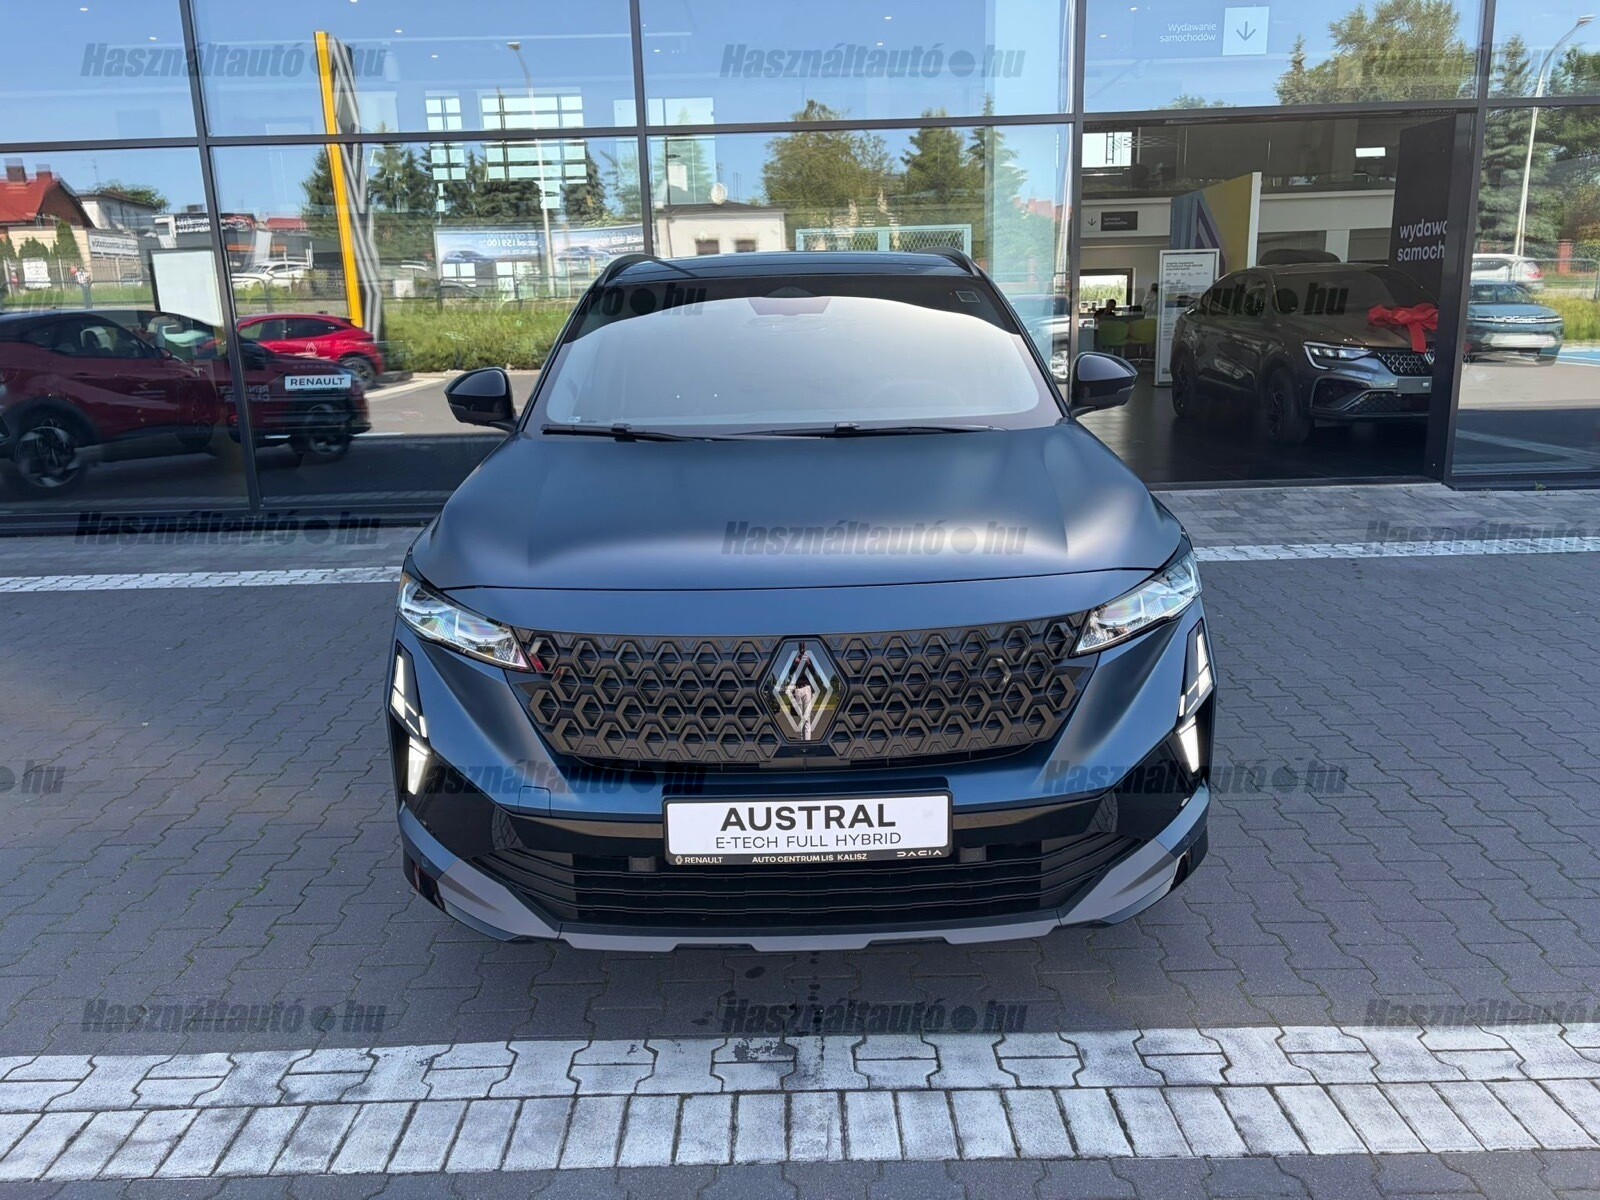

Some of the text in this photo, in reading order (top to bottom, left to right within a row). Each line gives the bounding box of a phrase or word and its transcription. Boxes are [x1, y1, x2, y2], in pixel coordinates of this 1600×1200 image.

[1167, 21, 1217, 33] Wydawanie
[1159, 33, 1217, 43] samochodów
[290, 377, 345, 387] RENAULT
[720, 803, 896, 832] AUSTRAL
[716, 832, 902, 849] E-TECH FULL HYBRID
[684, 849, 943, 865] RENAULT AUTO CENTRUM LIS KALISZ DACIA
